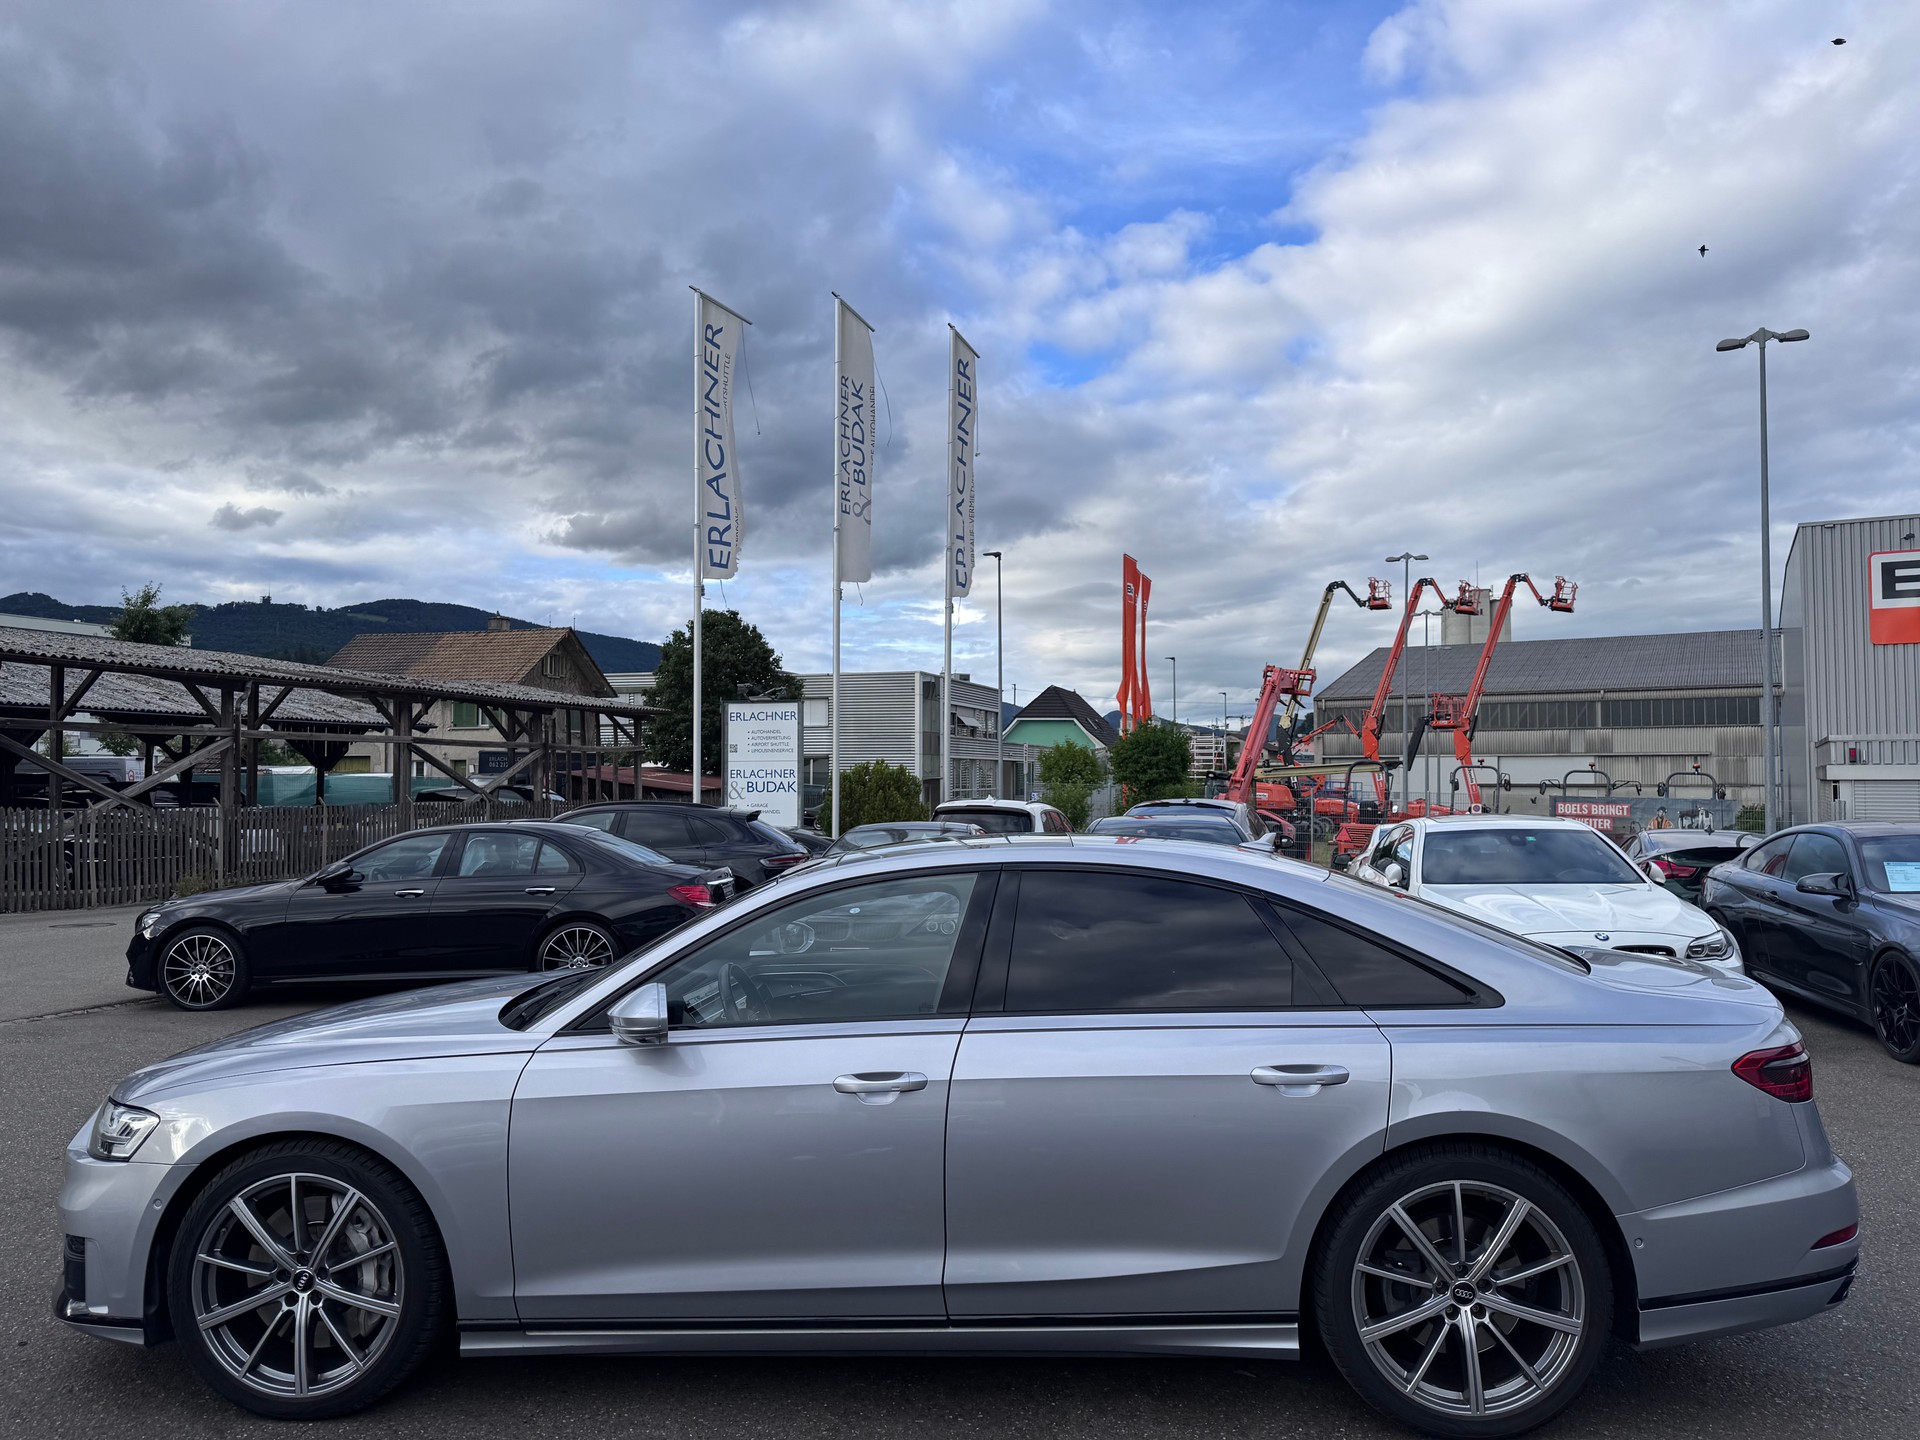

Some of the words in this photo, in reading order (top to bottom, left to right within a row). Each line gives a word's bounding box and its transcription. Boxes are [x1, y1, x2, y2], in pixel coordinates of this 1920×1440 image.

[704, 323, 732, 569] ERLACHNER
[840, 375, 851, 516] ERLACHNER
[851, 378, 866, 486] BUDAK
[852, 487, 872, 525] &
[729, 711, 797, 721] ERLACHNER
[730, 768, 796, 779] ERLACHNER
[729, 781, 746, 800] &
[746, 781, 797, 793] BUDAK
[1558, 803, 1588, 814] BOELS
[1591, 804, 1629, 816] BRINGT
